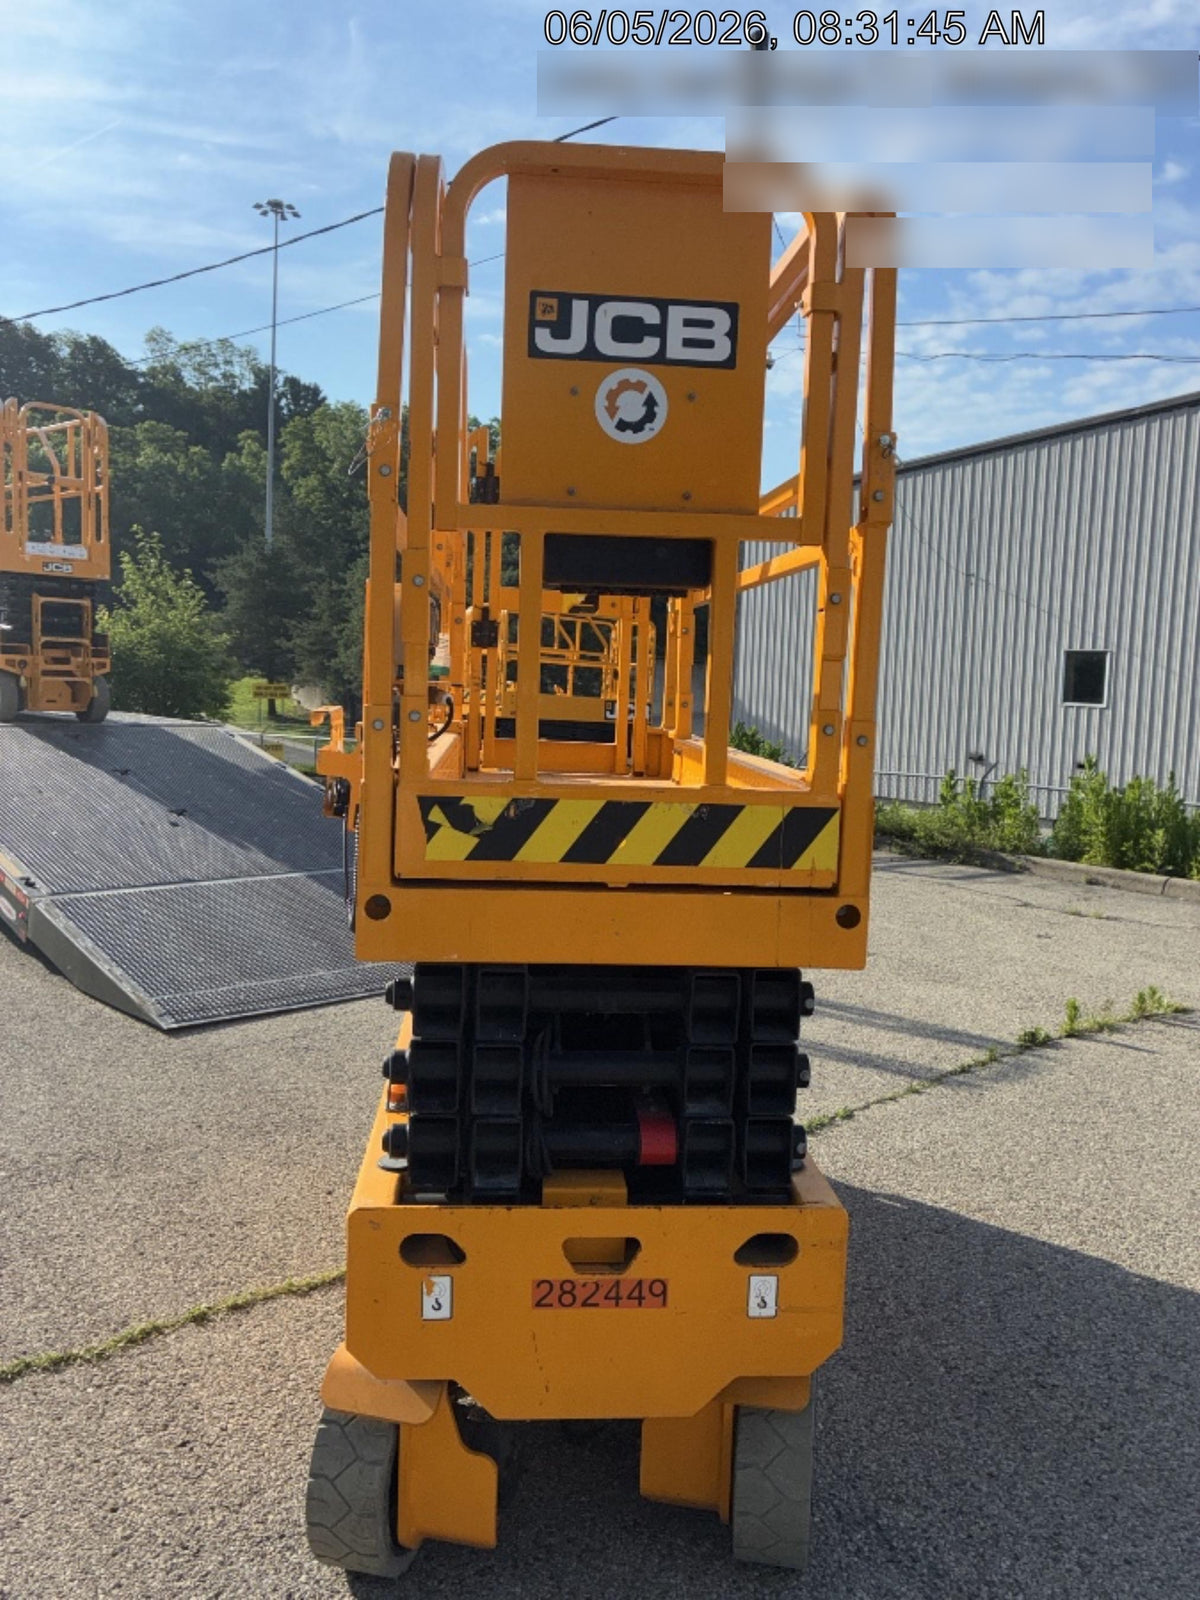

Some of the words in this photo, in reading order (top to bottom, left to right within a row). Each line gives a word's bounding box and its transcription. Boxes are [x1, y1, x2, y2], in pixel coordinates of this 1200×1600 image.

[534, 298, 732, 362] JCB
[43, 562, 73, 573] JCB
[534, 1278, 668, 1308] 282449
